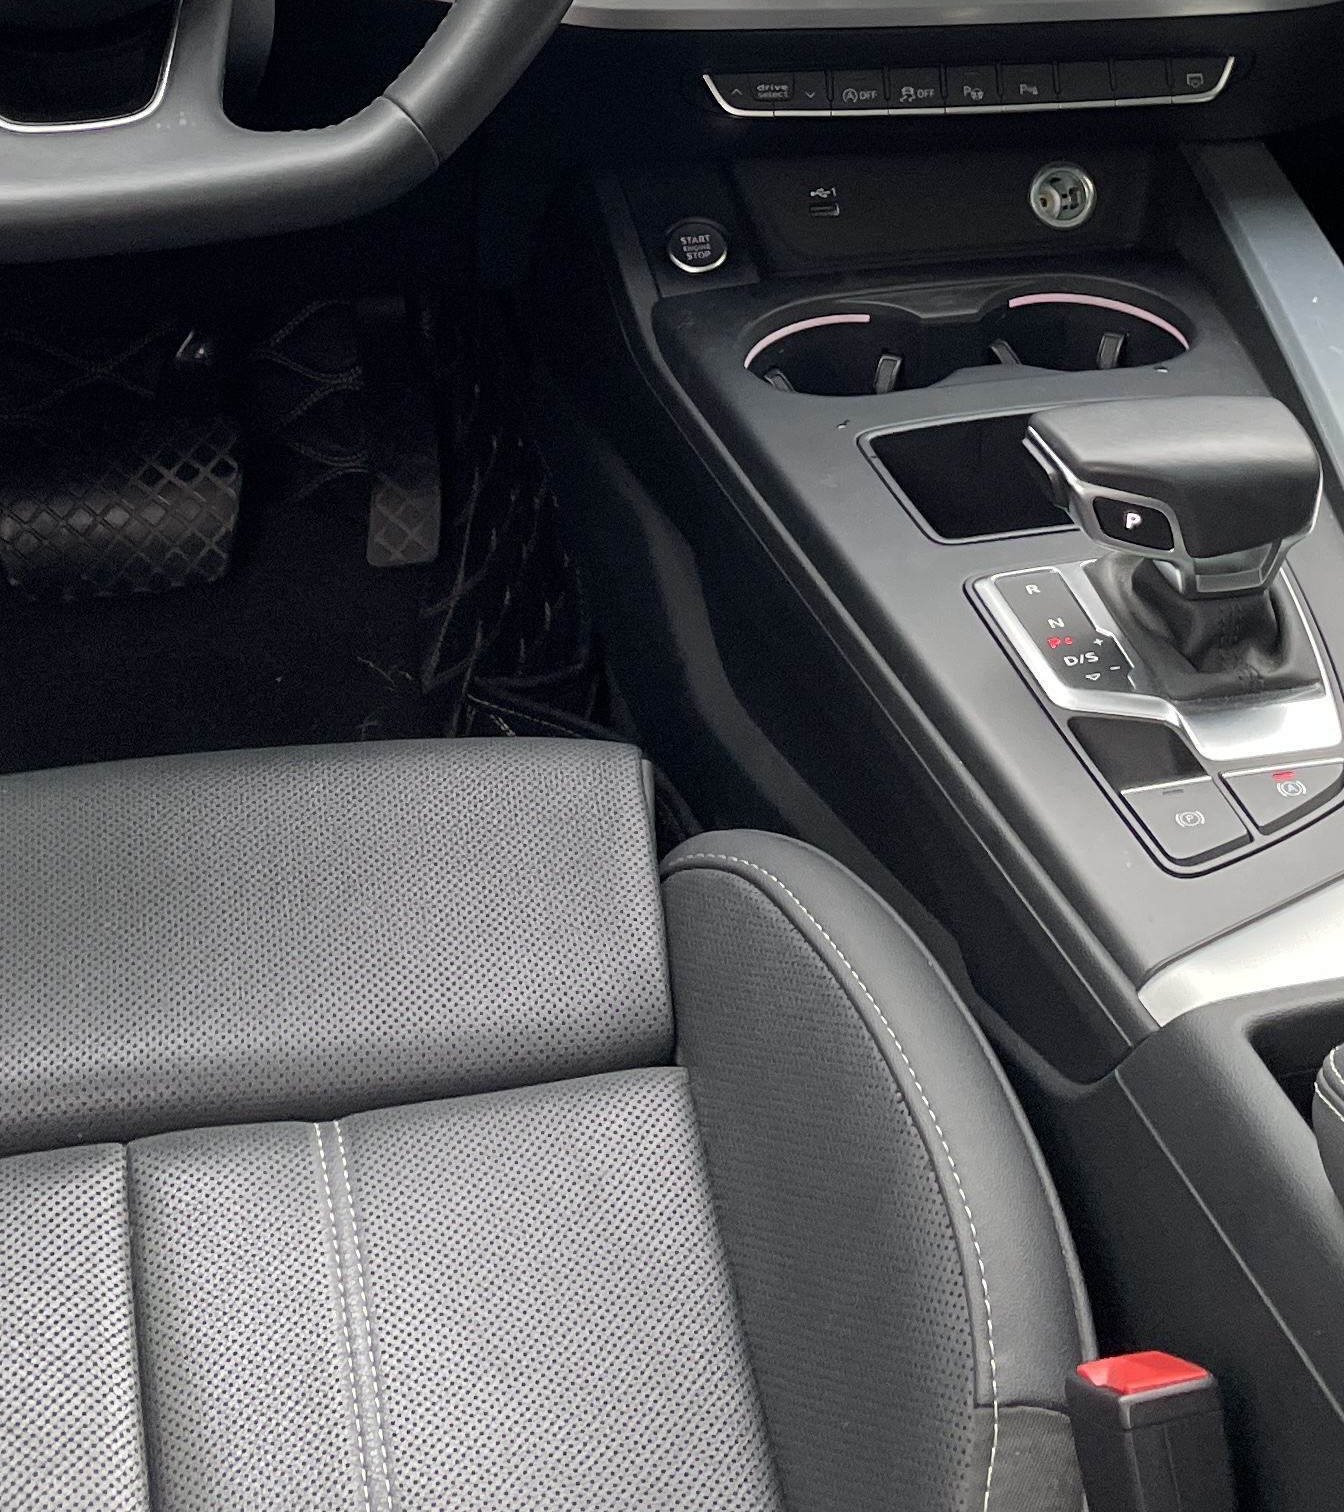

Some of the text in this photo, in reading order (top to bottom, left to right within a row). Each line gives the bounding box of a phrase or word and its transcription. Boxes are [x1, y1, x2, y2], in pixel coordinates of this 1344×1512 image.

[756, 82, 789, 92] drive
[859, 89, 878, 100] OFF
[916, 88, 936, 100] OFF
[680, 234, 711, 245] START
[686, 250, 712, 261] STOP
[1125, 512, 1142, 530] P
[1025, 584, 1041, 595] R
[1047, 617, 1065, 629] N
[1063, 651, 1099, 666] D/S
